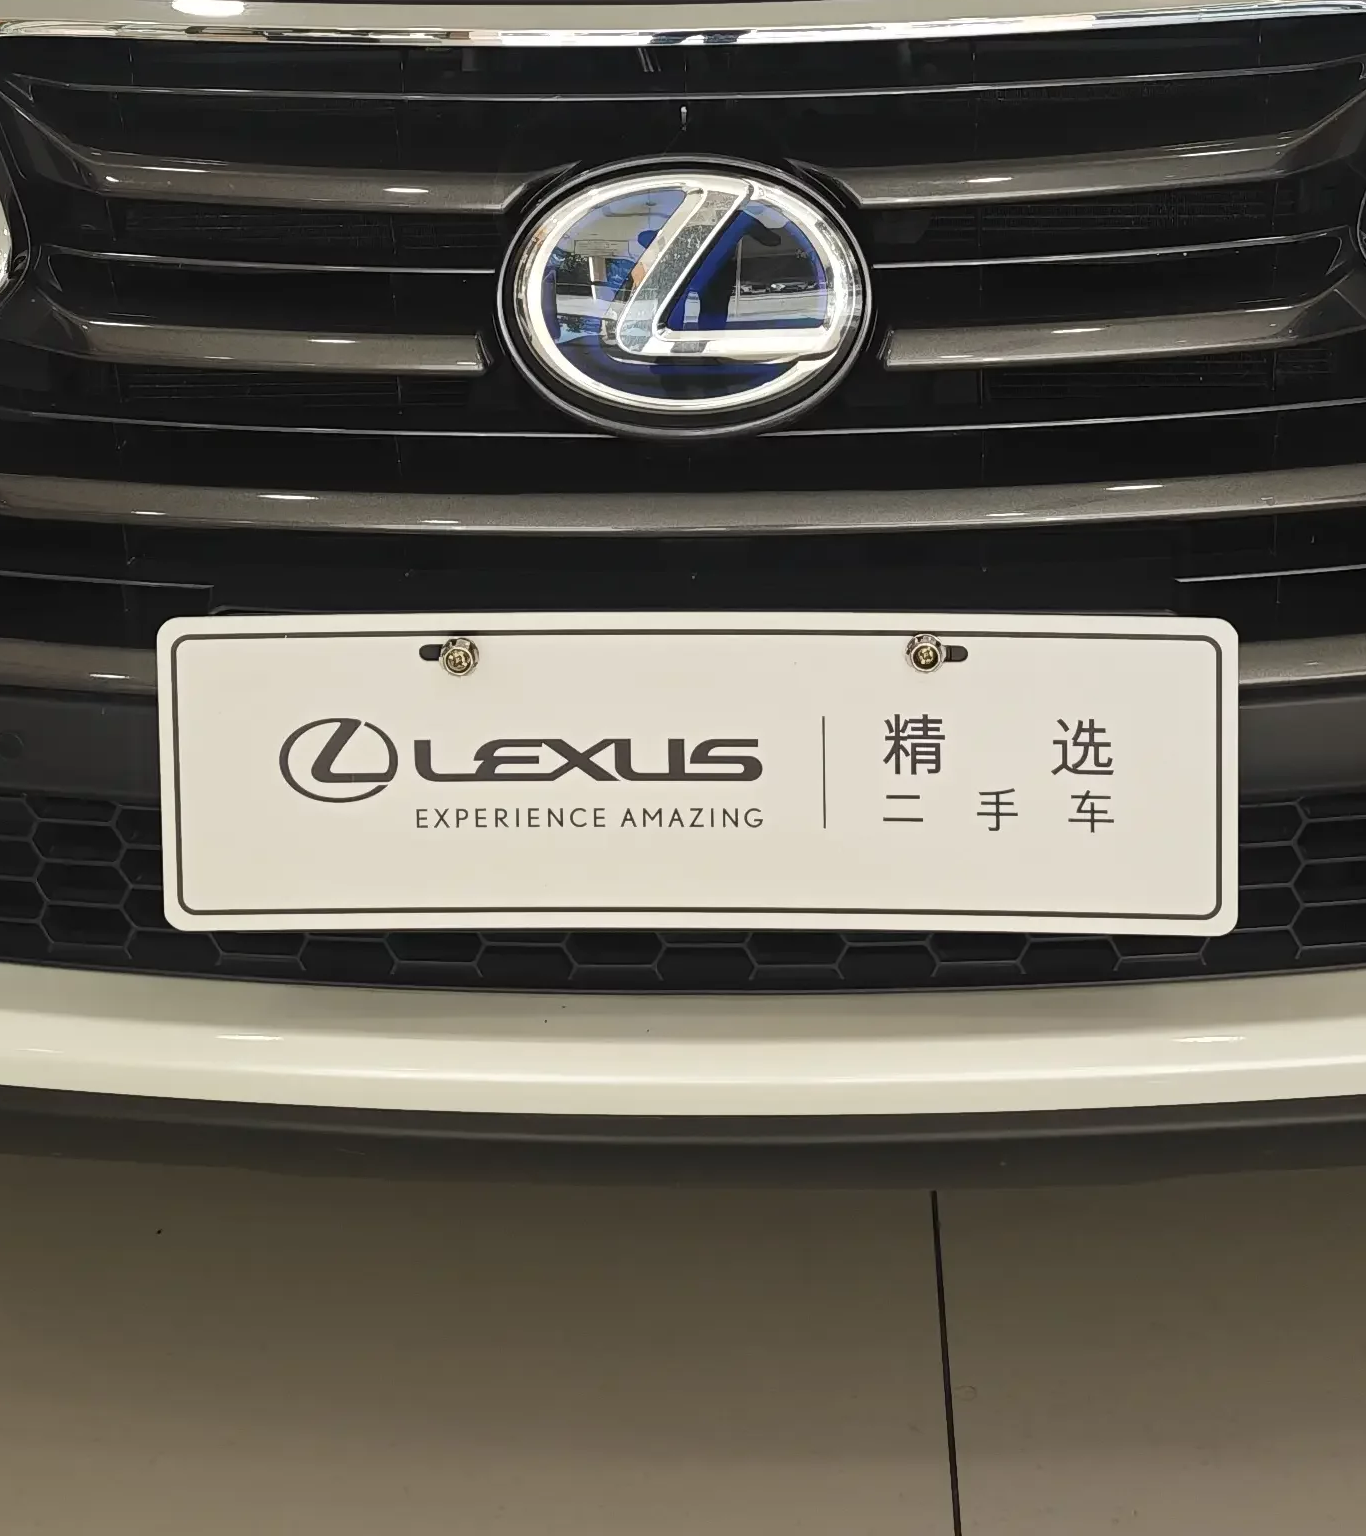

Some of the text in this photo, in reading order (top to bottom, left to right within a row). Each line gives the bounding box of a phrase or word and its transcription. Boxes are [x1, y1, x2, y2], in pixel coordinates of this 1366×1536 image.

[413, 738, 763, 783] LEXUS
[415, 807, 764, 829] EXPERIENCE AMAZING
[882, 788, 1115, 833] 二手车
